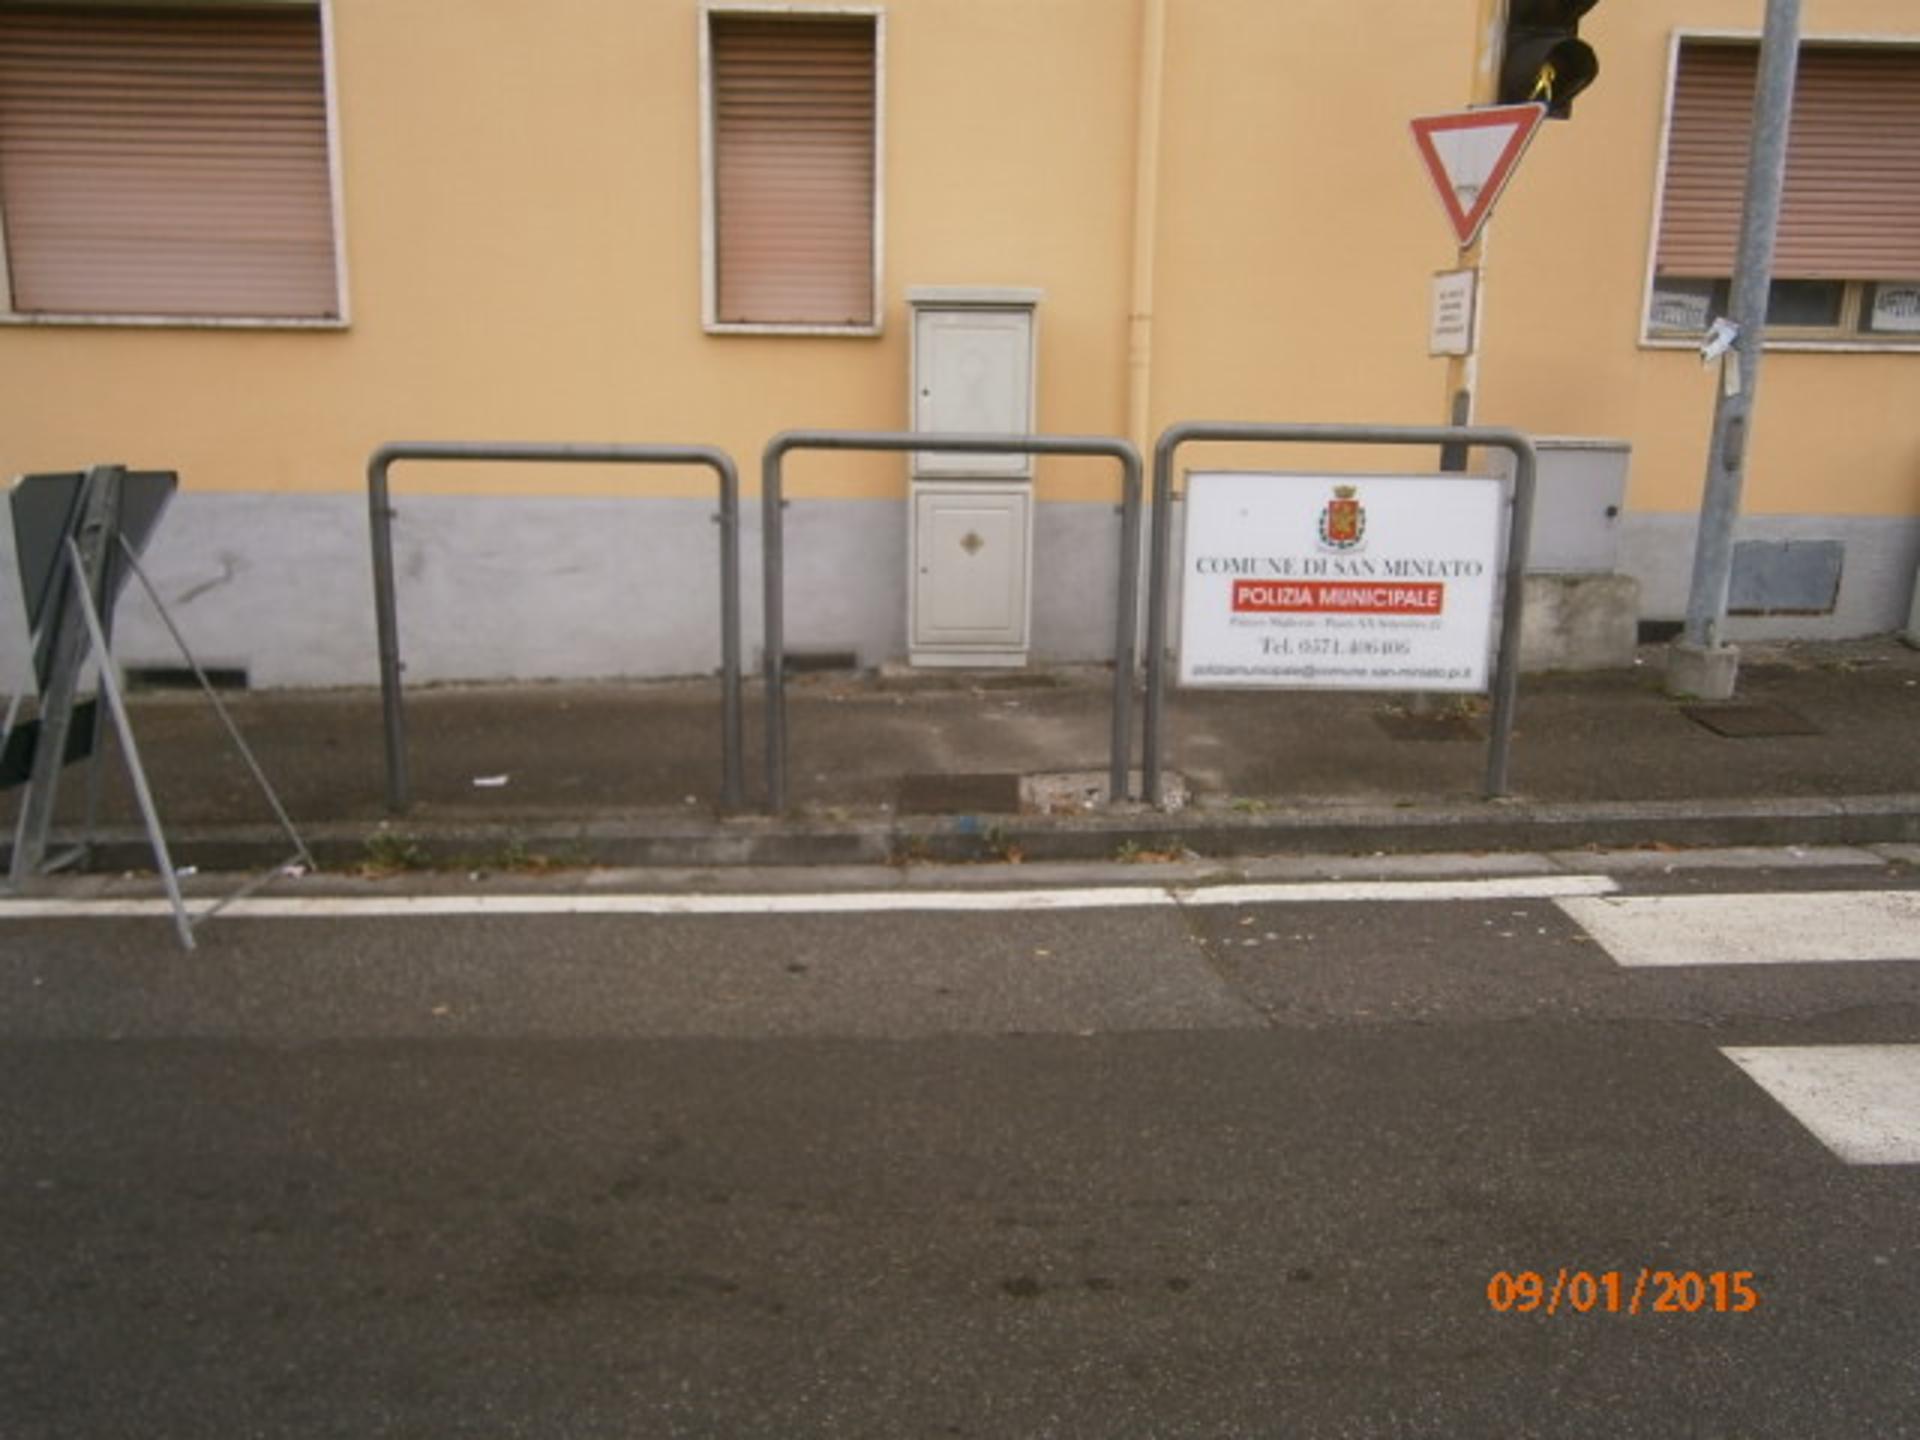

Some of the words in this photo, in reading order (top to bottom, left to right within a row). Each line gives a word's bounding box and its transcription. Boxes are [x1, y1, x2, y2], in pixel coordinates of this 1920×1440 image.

[1196, 557, 1298, 576] COMUNE
[1303, 558, 1328, 576] DI
[1333, 558, 1376, 577] SAN
[1383, 559, 1483, 578] MINIATO
[1237, 586, 1314, 606] POLIZIA
[1319, 587, 1439, 608] MUNICIPALE
[1261, 637, 1294, 655] Tel.
